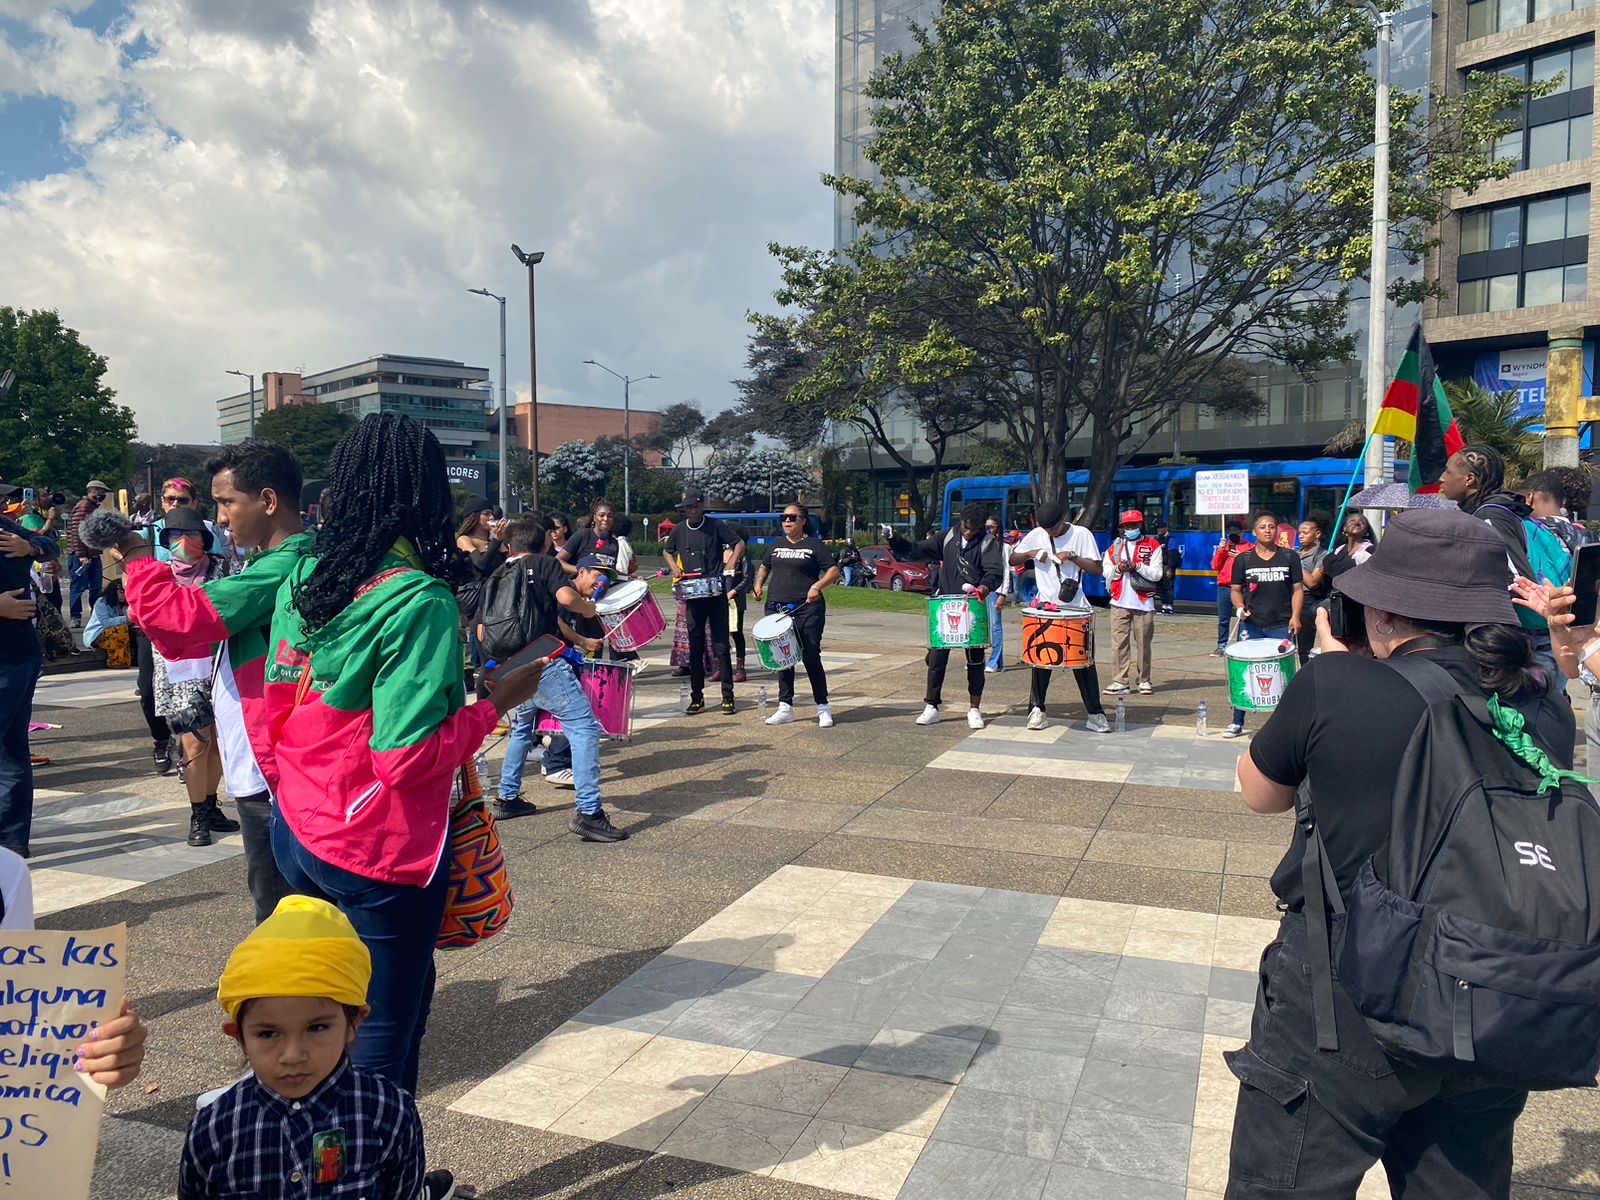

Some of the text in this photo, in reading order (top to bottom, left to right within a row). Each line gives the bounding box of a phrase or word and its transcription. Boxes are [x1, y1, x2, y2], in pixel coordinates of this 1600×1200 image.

[1512, 362, 1547, 372] WYNDH
[61, 937, 118, 968] las
[0, 979, 106, 1017] lguna
[0, 1016, 98, 1040] otivo
